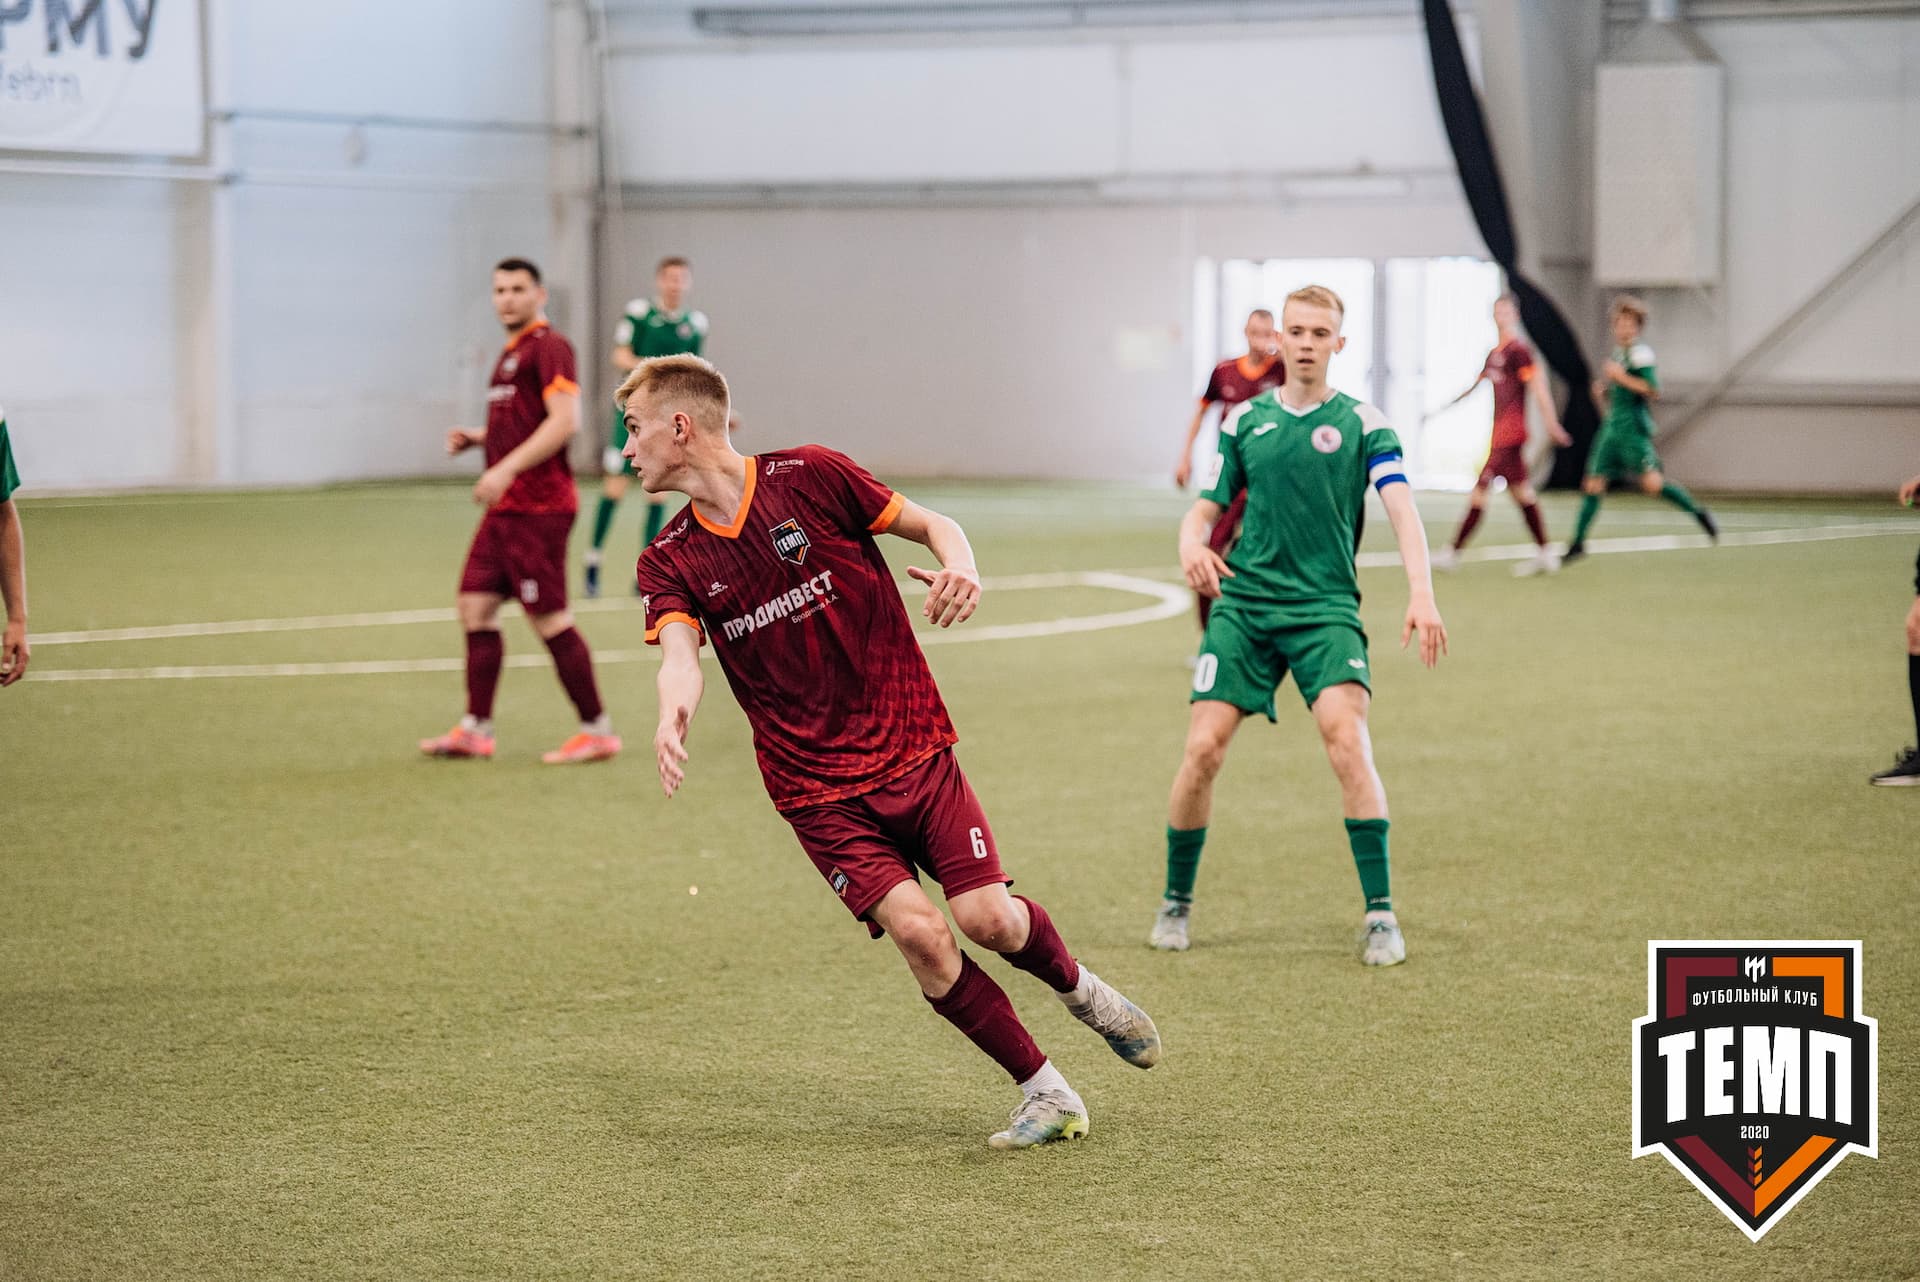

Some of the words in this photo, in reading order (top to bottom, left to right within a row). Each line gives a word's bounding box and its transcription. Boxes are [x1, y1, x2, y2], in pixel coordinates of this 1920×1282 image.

[776, 531, 806, 555] ТЕМП
[721, 569, 833, 642] ПРОДИНВЕСТ
[969, 826, 988, 859] 6
